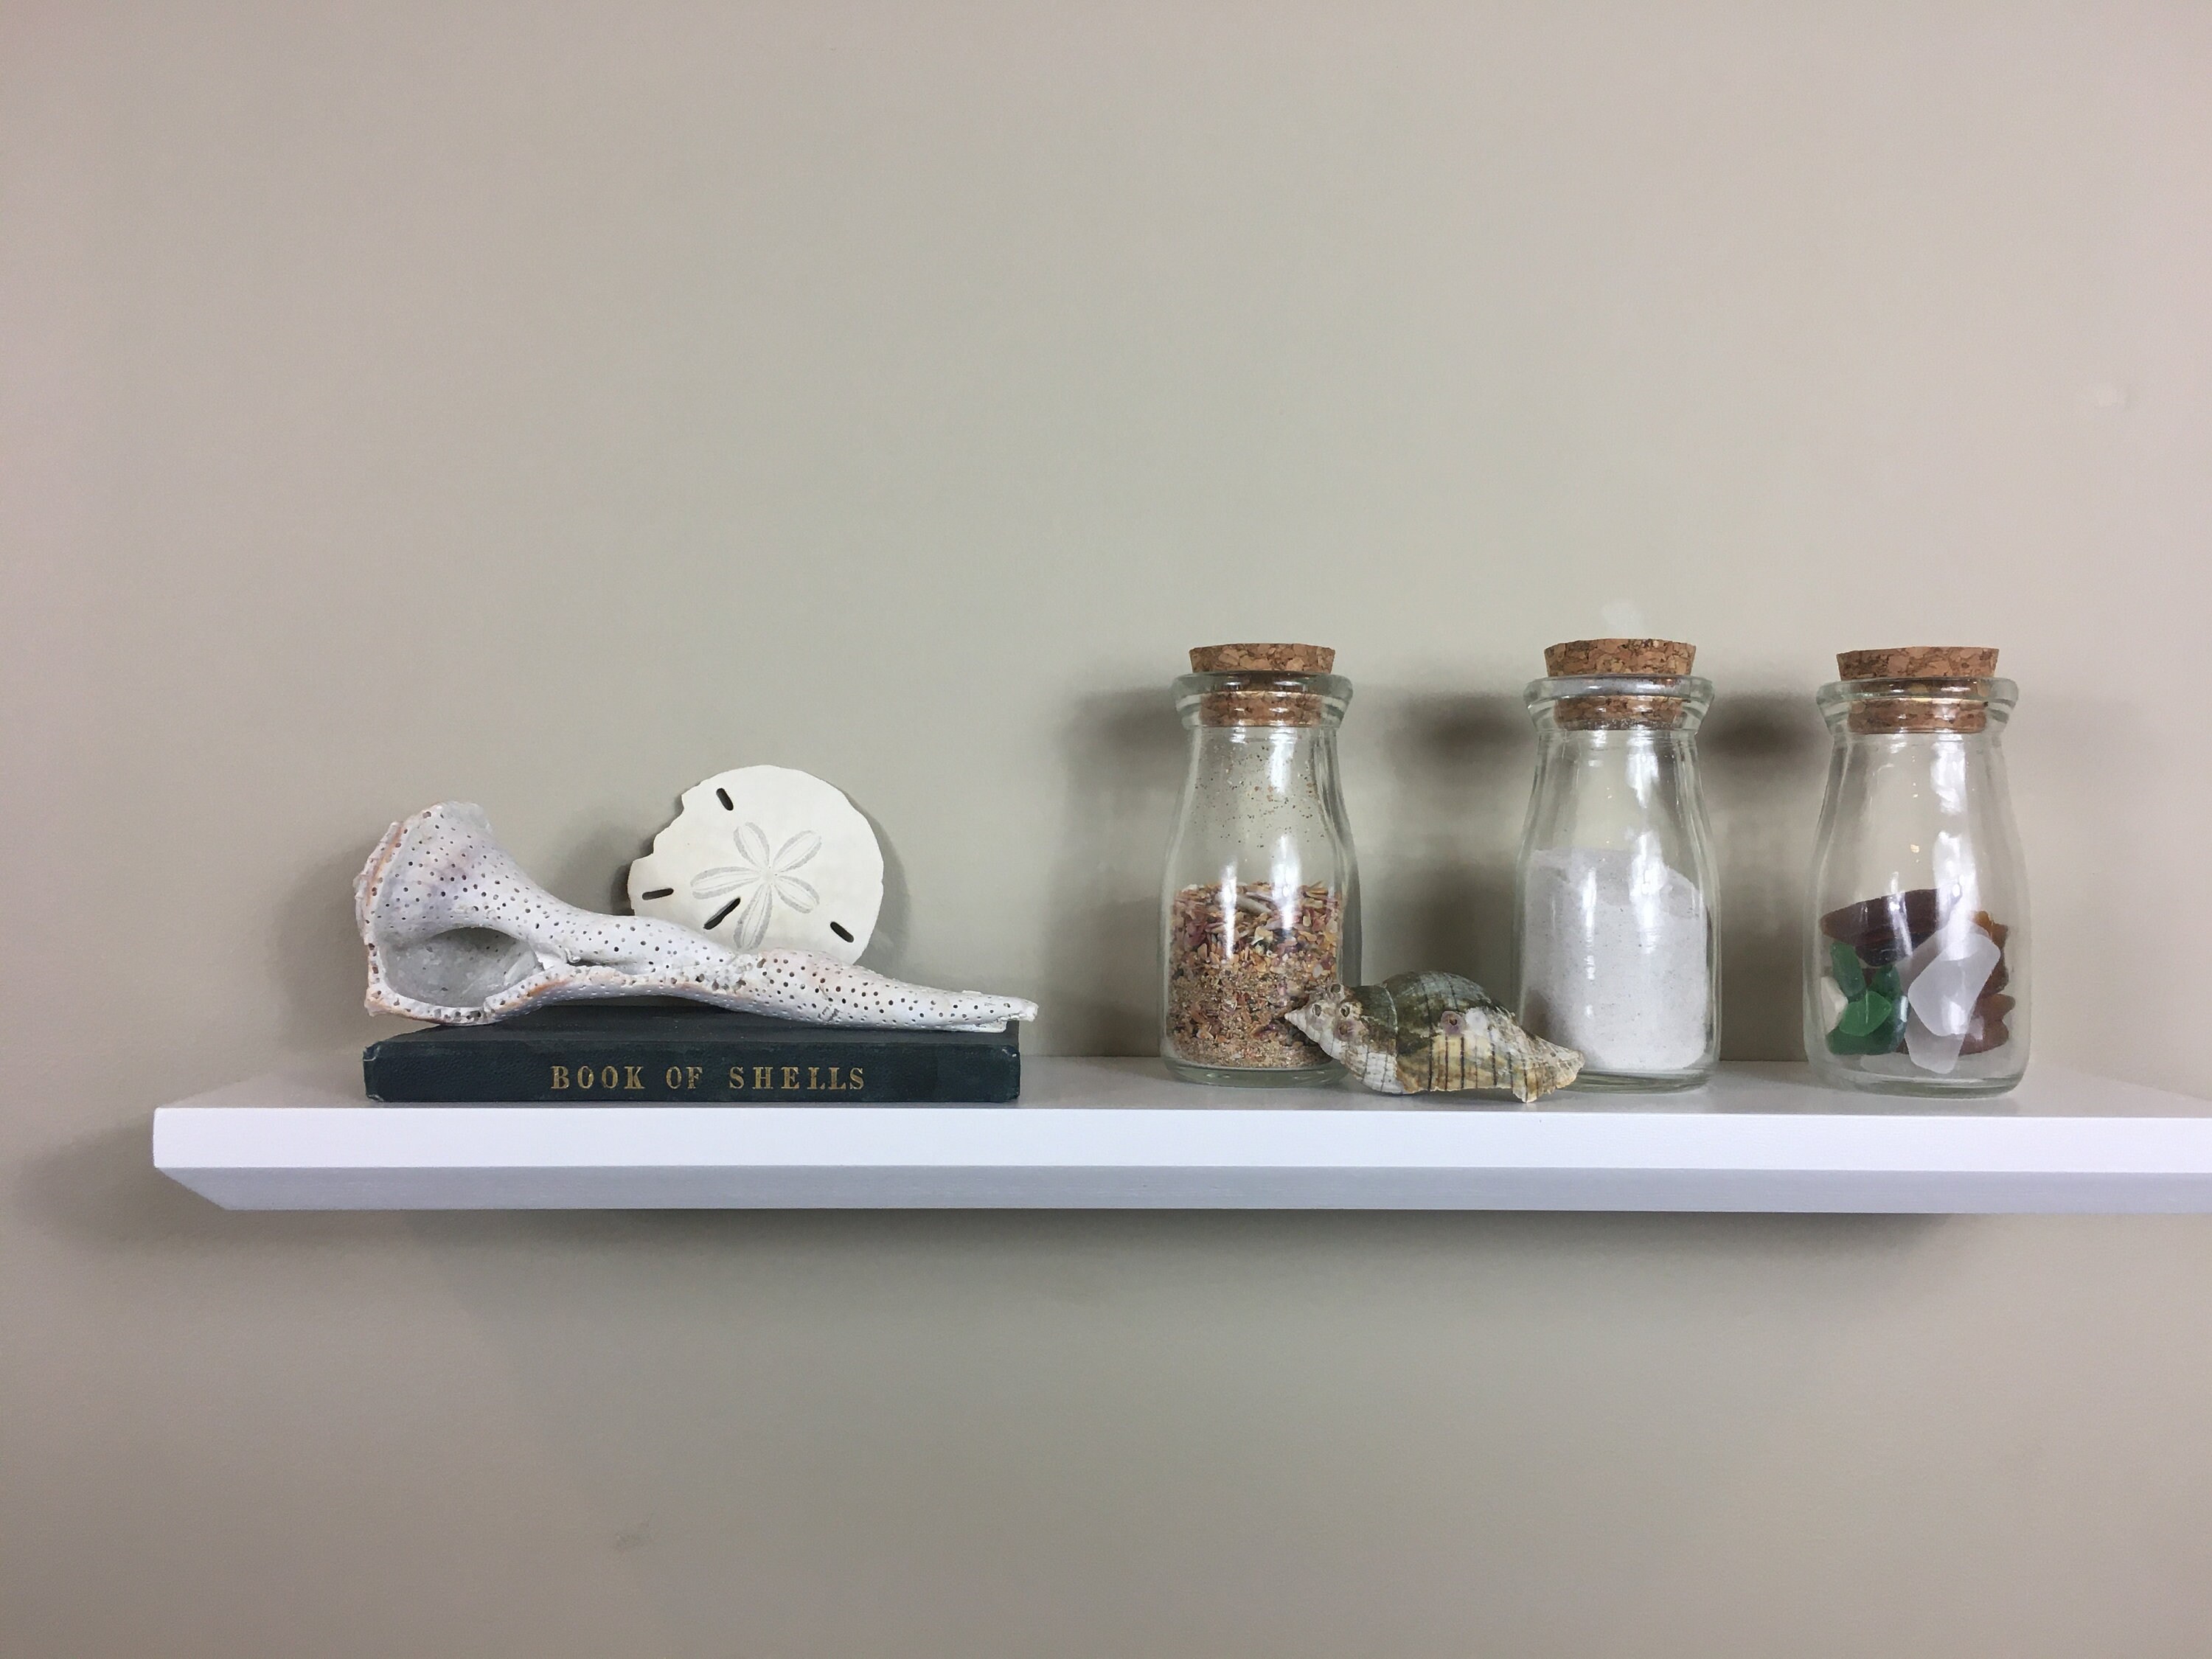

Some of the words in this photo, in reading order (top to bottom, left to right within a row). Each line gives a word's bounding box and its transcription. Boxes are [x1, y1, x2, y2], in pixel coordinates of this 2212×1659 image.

[551, 1065, 645, 1090] BOOK
[666, 1066, 703, 1090] OF
[728, 1066, 865, 1090] SHELLS
